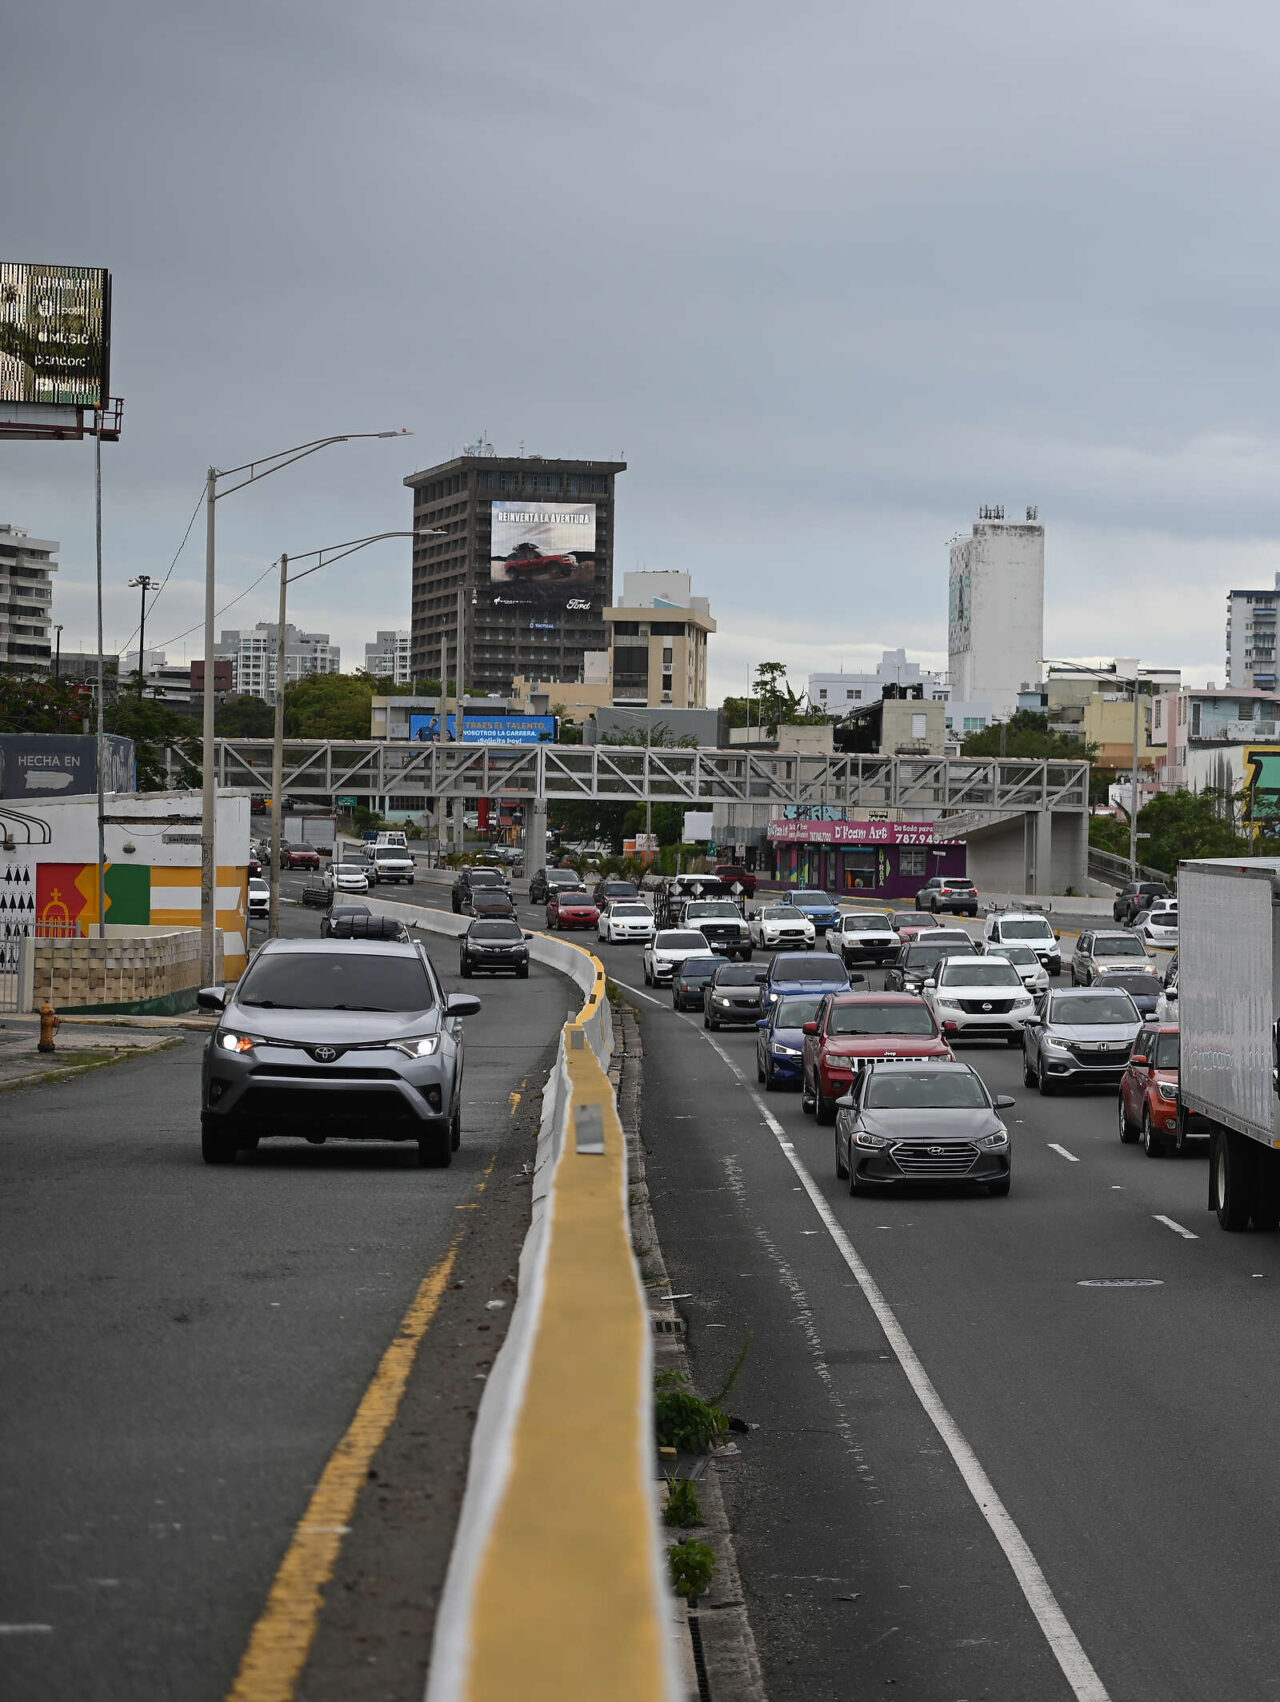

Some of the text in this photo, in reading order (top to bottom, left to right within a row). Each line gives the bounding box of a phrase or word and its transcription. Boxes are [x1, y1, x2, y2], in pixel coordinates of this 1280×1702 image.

[498, 512, 590, 525] REINVENTA LA AVENTURA
[566, 599, 592, 610] Ford
[466, 722, 493, 730] TRAES
[495, 722, 504, 730] EL
[506, 722, 547, 731] TALENTO,
[18, 755, 81, 767] HECHA EN
[834, 825, 867, 840] D'Foam
[868, 825, 888, 840] Art
